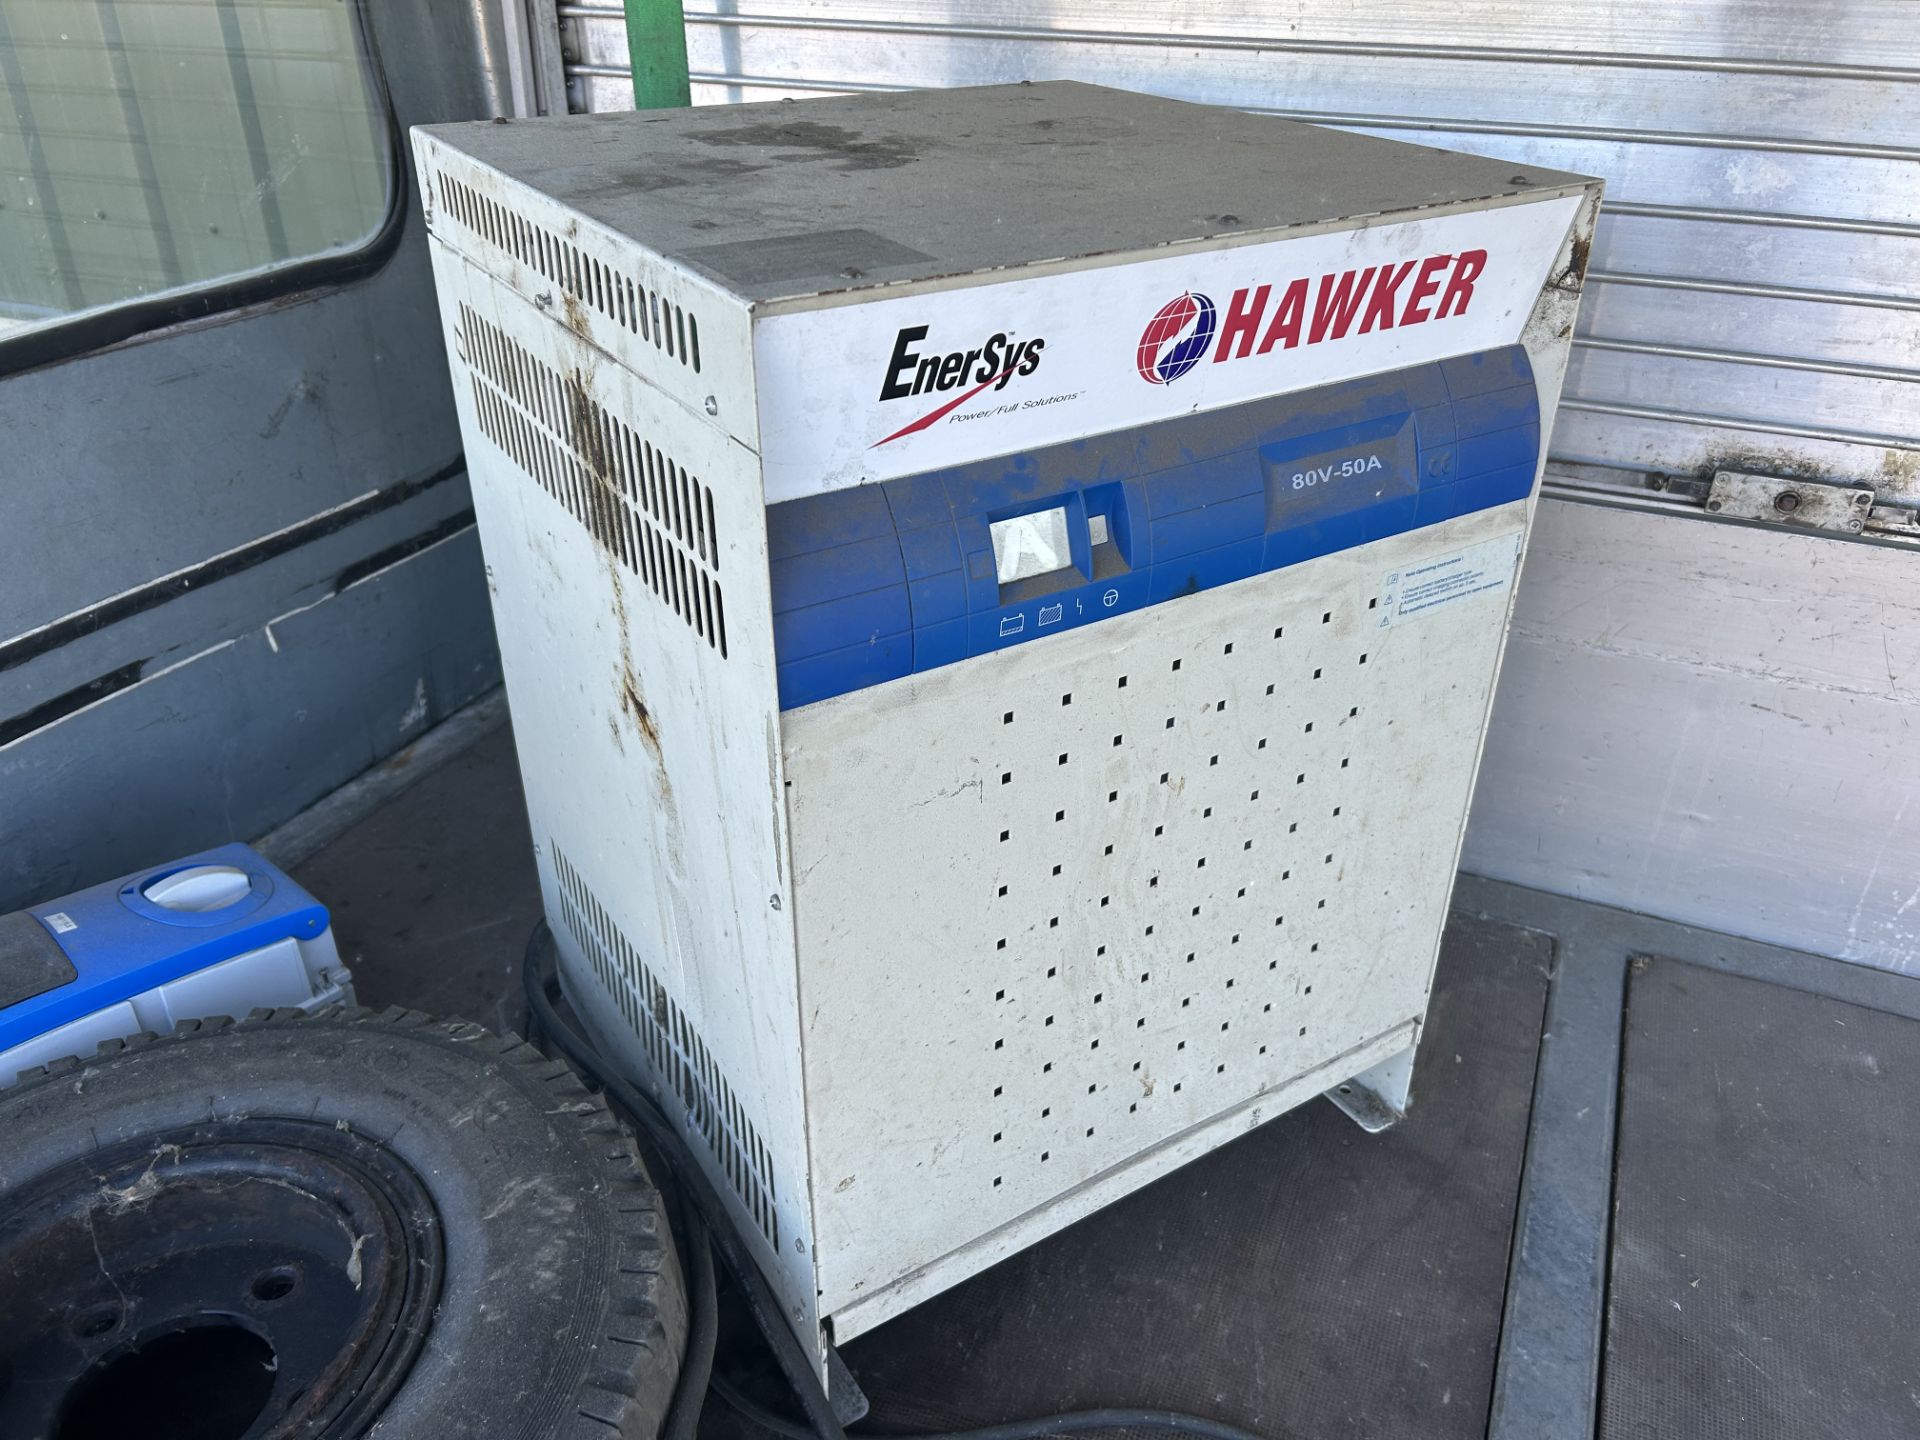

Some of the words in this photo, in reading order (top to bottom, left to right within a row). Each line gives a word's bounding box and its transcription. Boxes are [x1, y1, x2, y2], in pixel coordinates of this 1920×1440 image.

[1213, 249, 1487, 364] HAWKER
[879, 325, 1045, 402] EnerSys
[949, 402, 1019, 424] Power/Full
[1021, 393, 1079, 410] Solutions
[1291, 455, 1383, 490] 80V-50A
